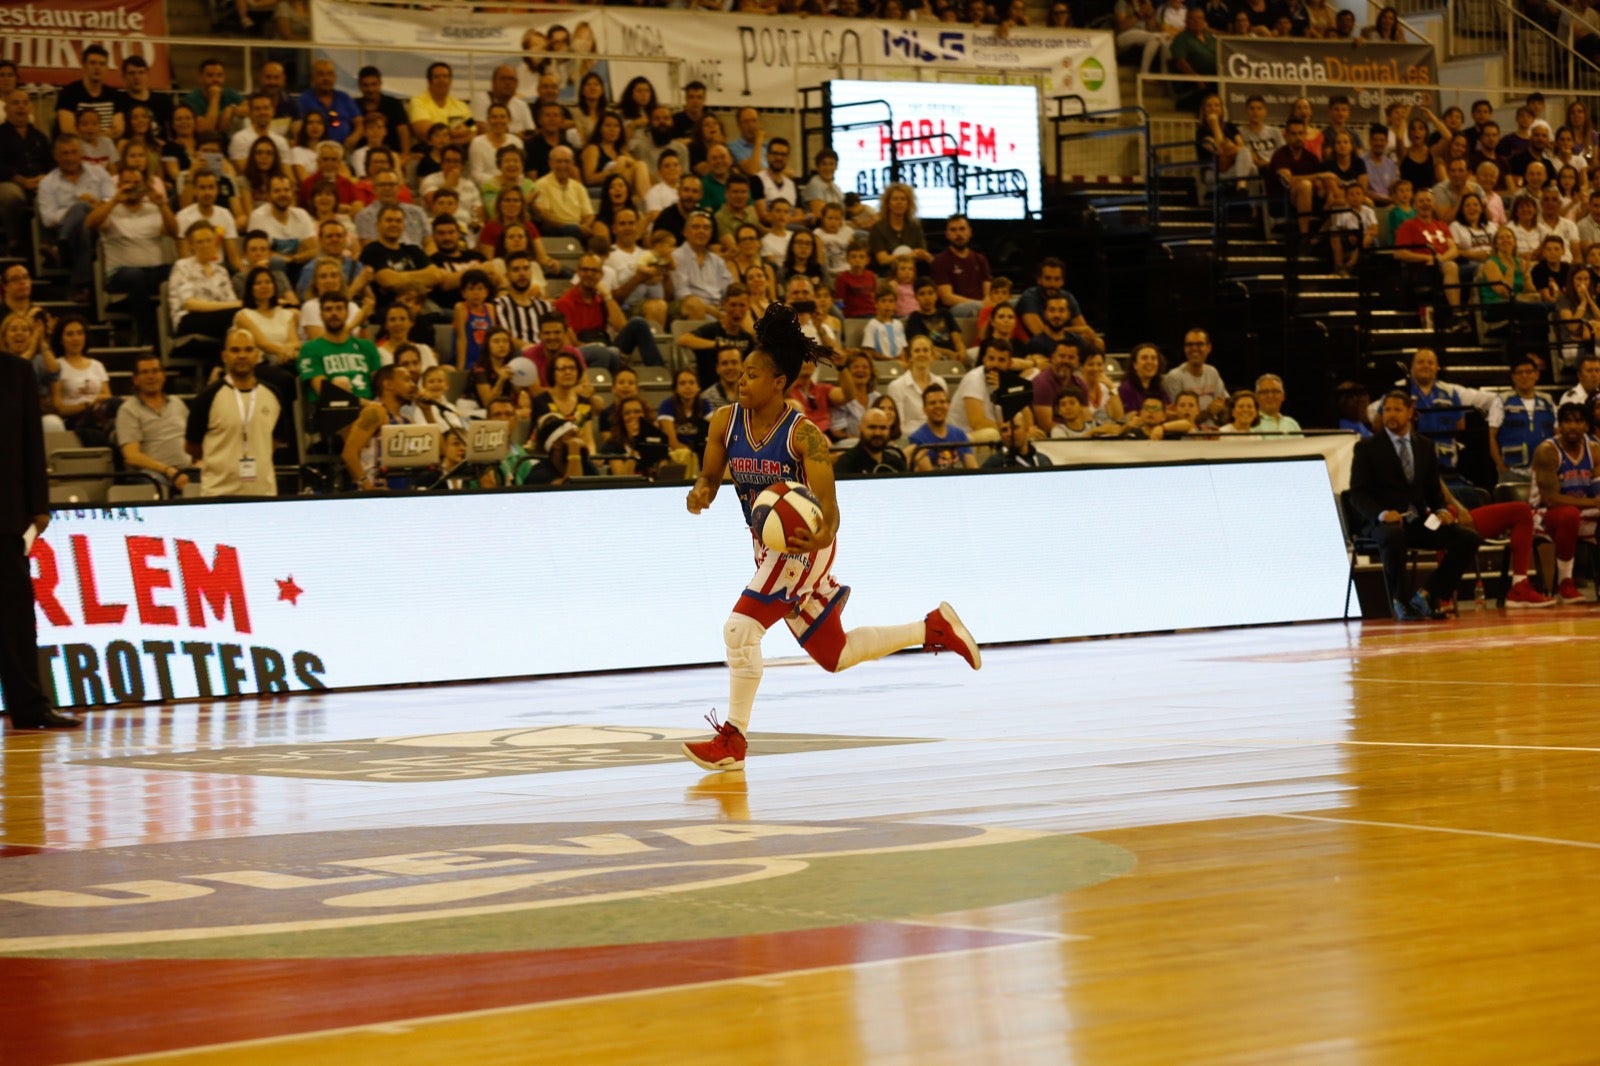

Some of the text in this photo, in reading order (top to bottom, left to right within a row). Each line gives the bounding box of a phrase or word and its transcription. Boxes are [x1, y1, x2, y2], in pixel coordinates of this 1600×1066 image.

[878, 118, 997, 163] HARLEM
[323, 353, 369, 375] CELTICS
[732, 457, 782, 476] HARLEM
